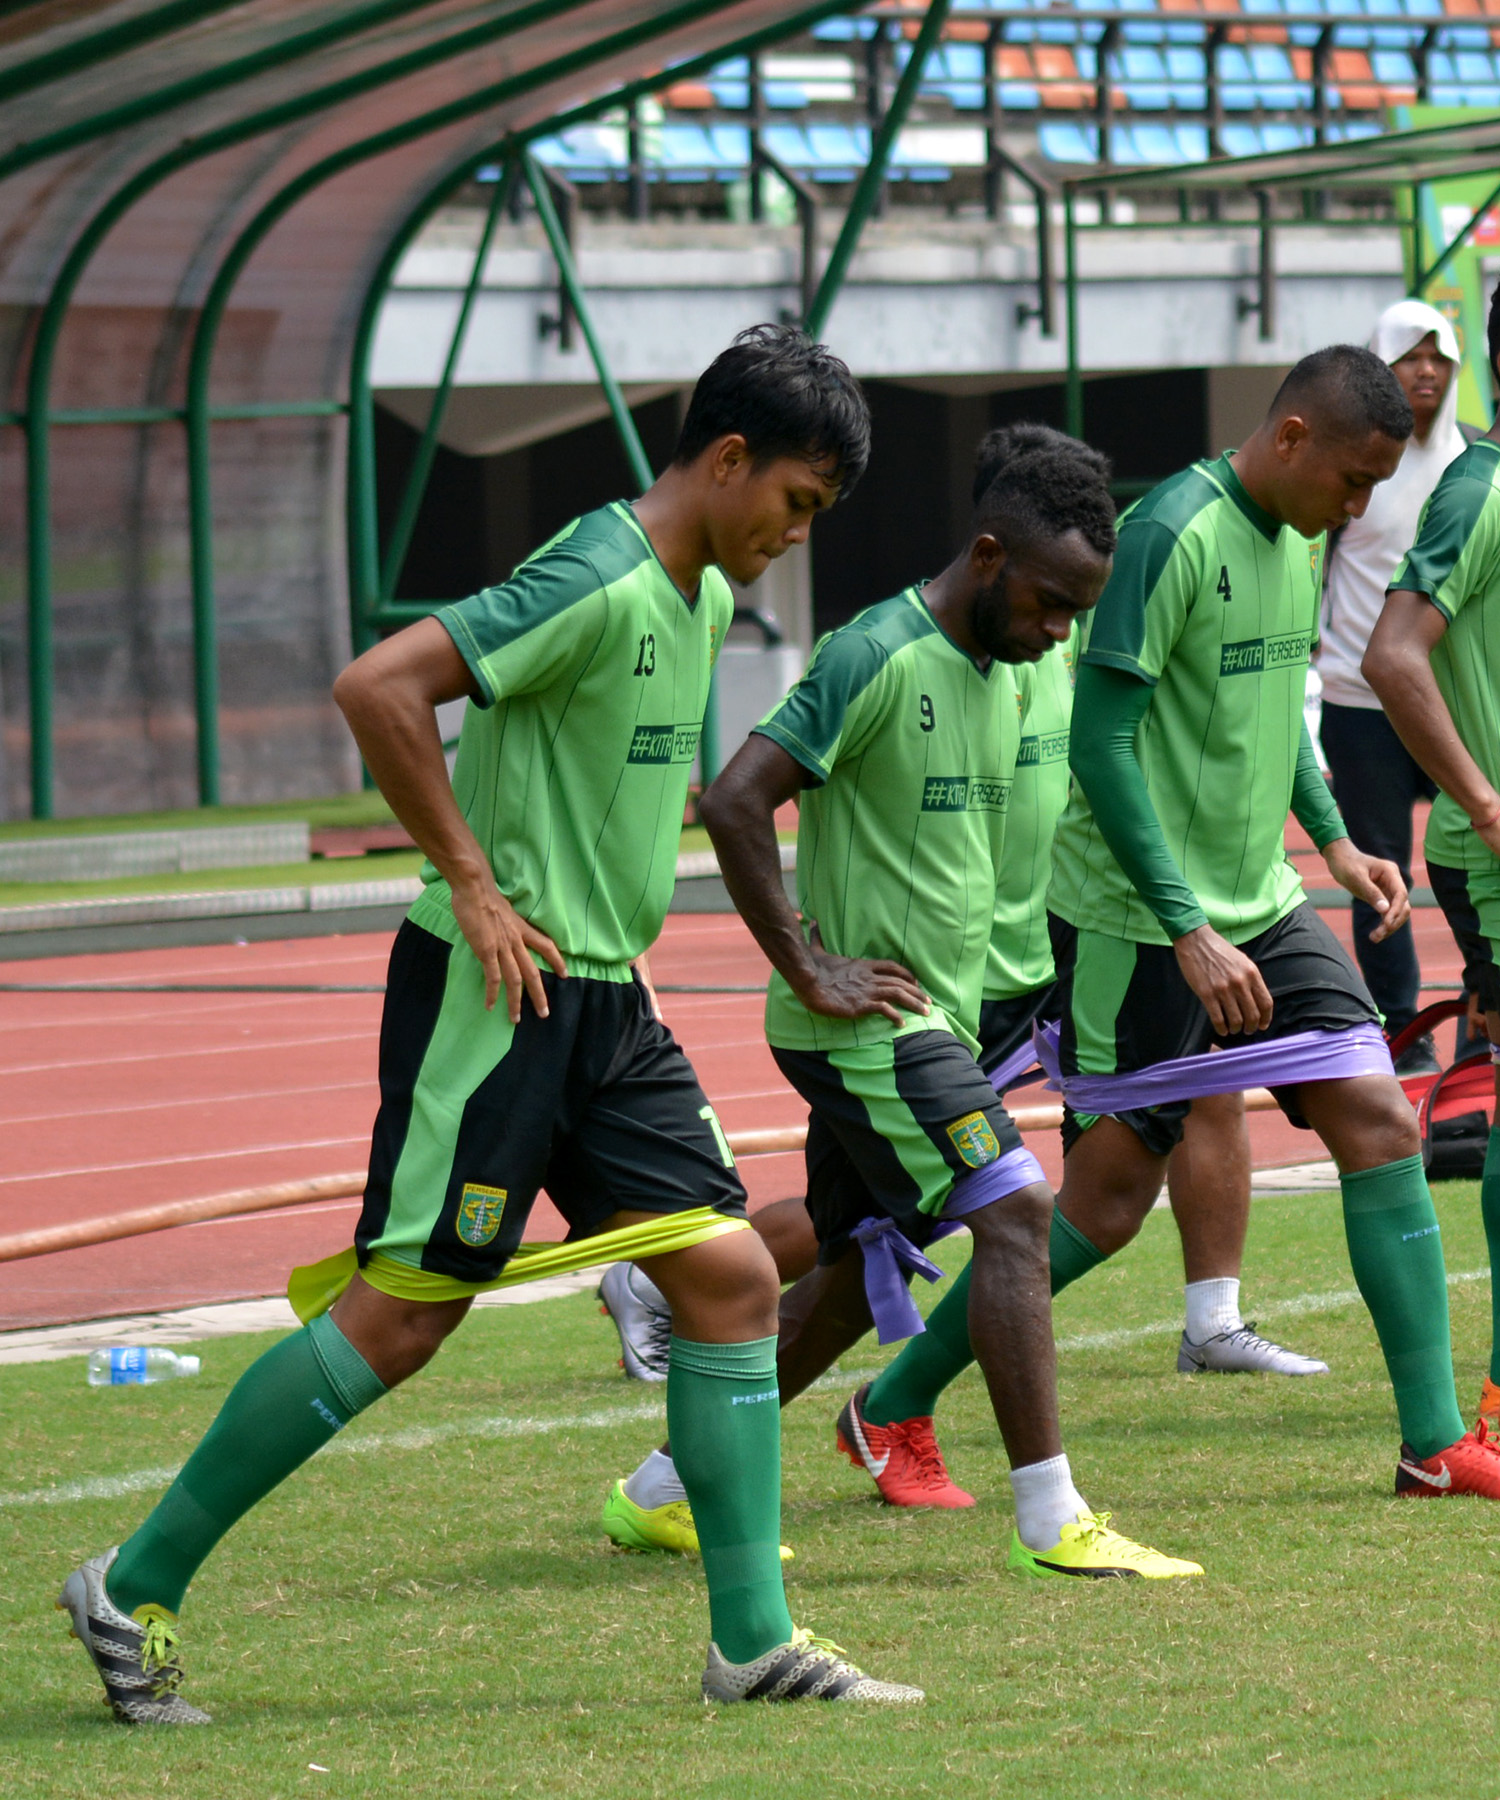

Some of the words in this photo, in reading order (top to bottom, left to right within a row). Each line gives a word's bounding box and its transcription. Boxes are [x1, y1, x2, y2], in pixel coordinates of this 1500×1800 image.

[1217, 565, 1232, 602] 4
[634, 634, 656, 676] 13
[920, 694, 936, 733] 9
